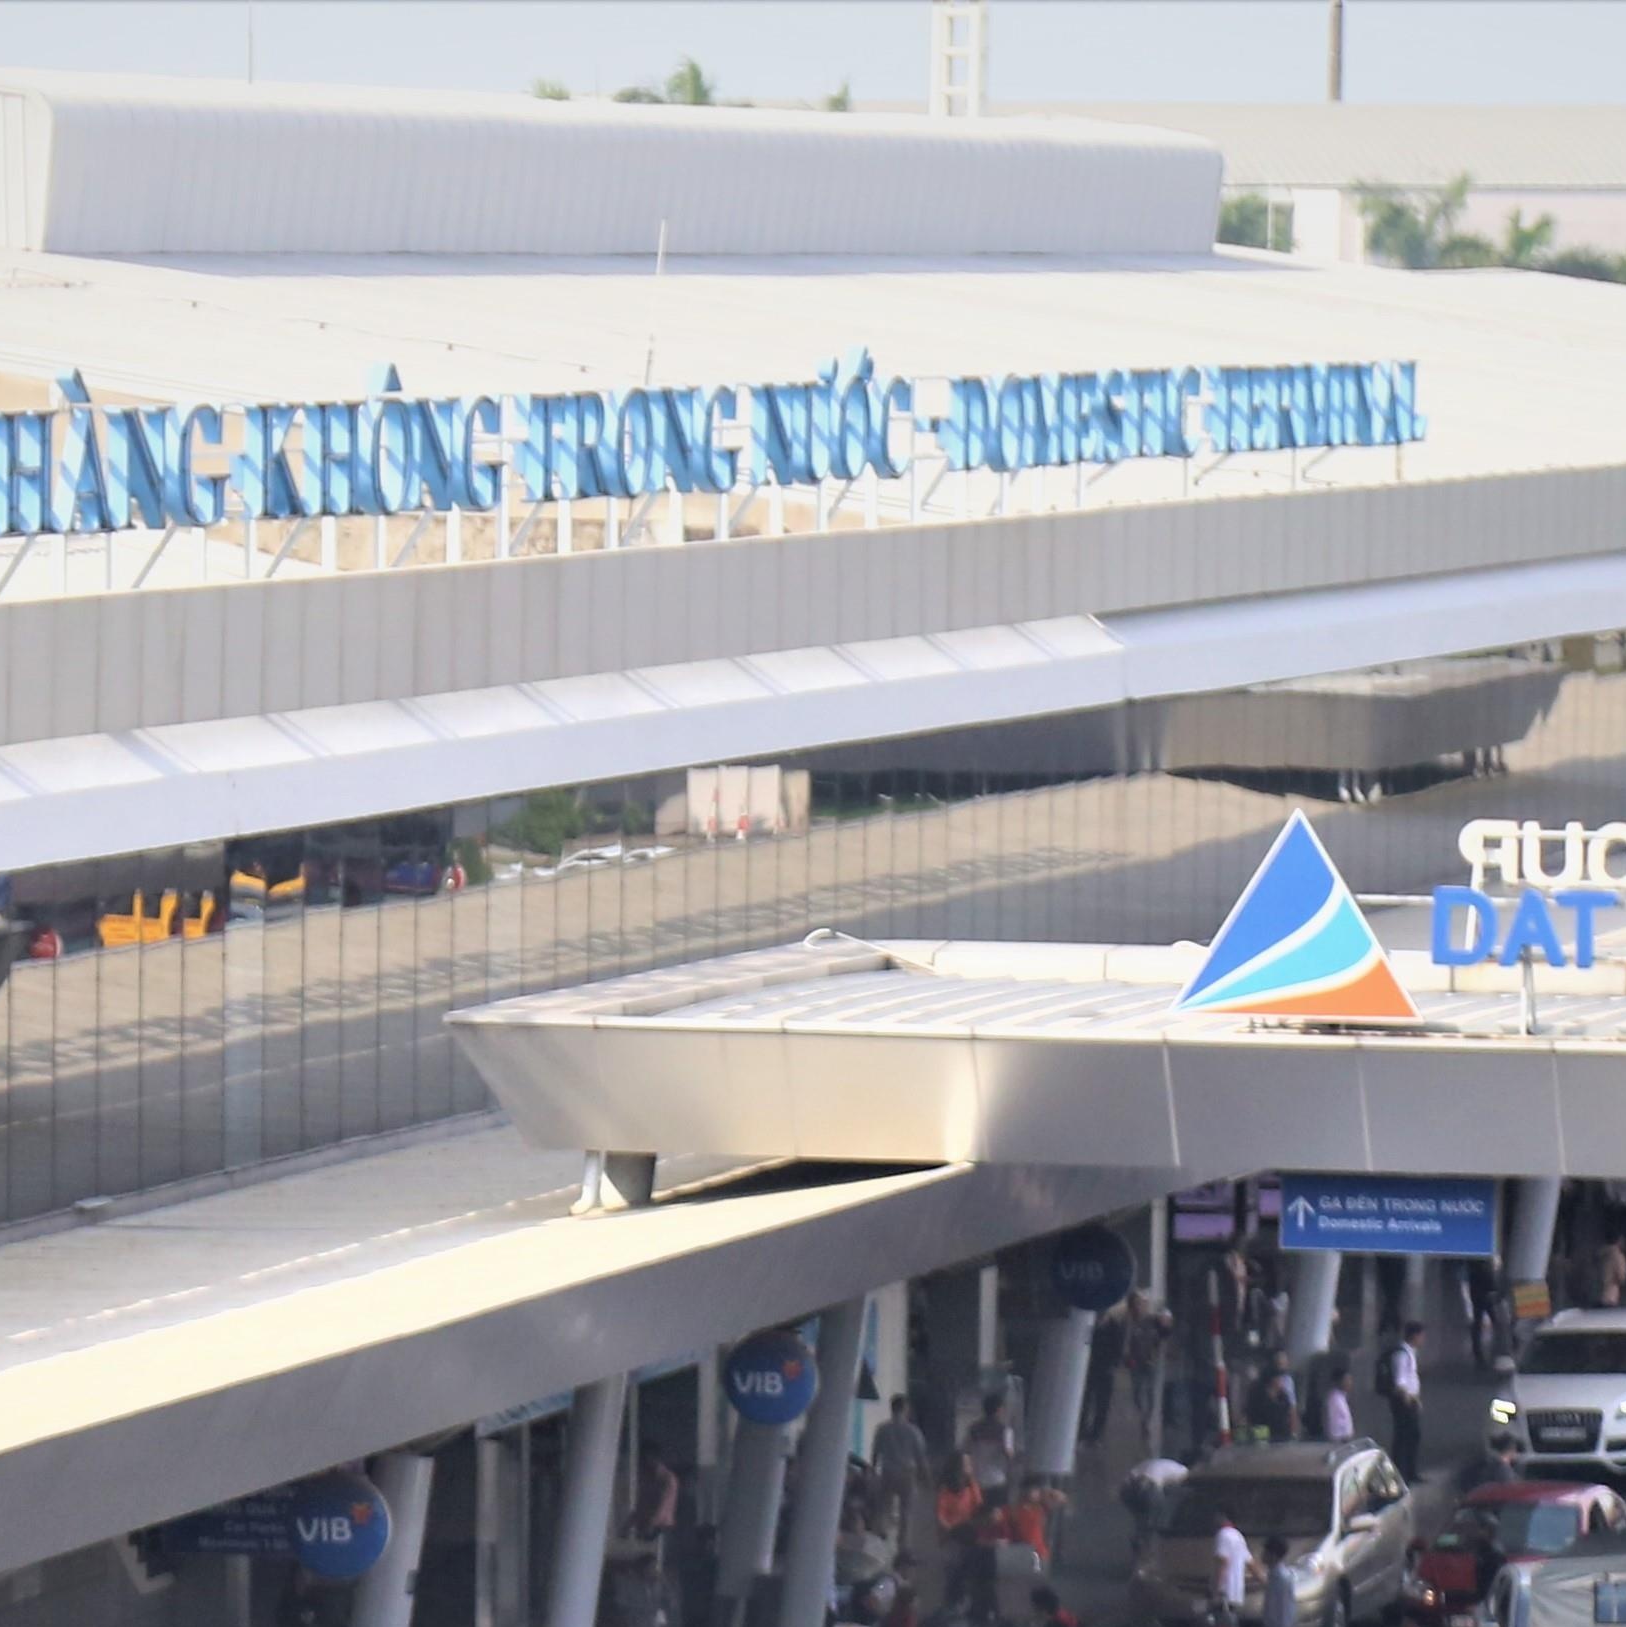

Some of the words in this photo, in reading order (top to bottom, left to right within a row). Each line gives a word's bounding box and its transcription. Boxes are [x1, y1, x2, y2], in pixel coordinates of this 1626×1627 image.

[231, 363, 502, 520] KHÔNG
[522, 385, 741, 502] TRONG
[1431, 885, 1619, 968] DAT
[1383, 1197, 1436, 1212] TRONG
[1318, 1215, 1383, 1230] Domestic
[1387, 1217, 1442, 1232] Arrivals
[733, 1370, 784, 1395] VIB
[296, 1517, 353, 1542] VIB
